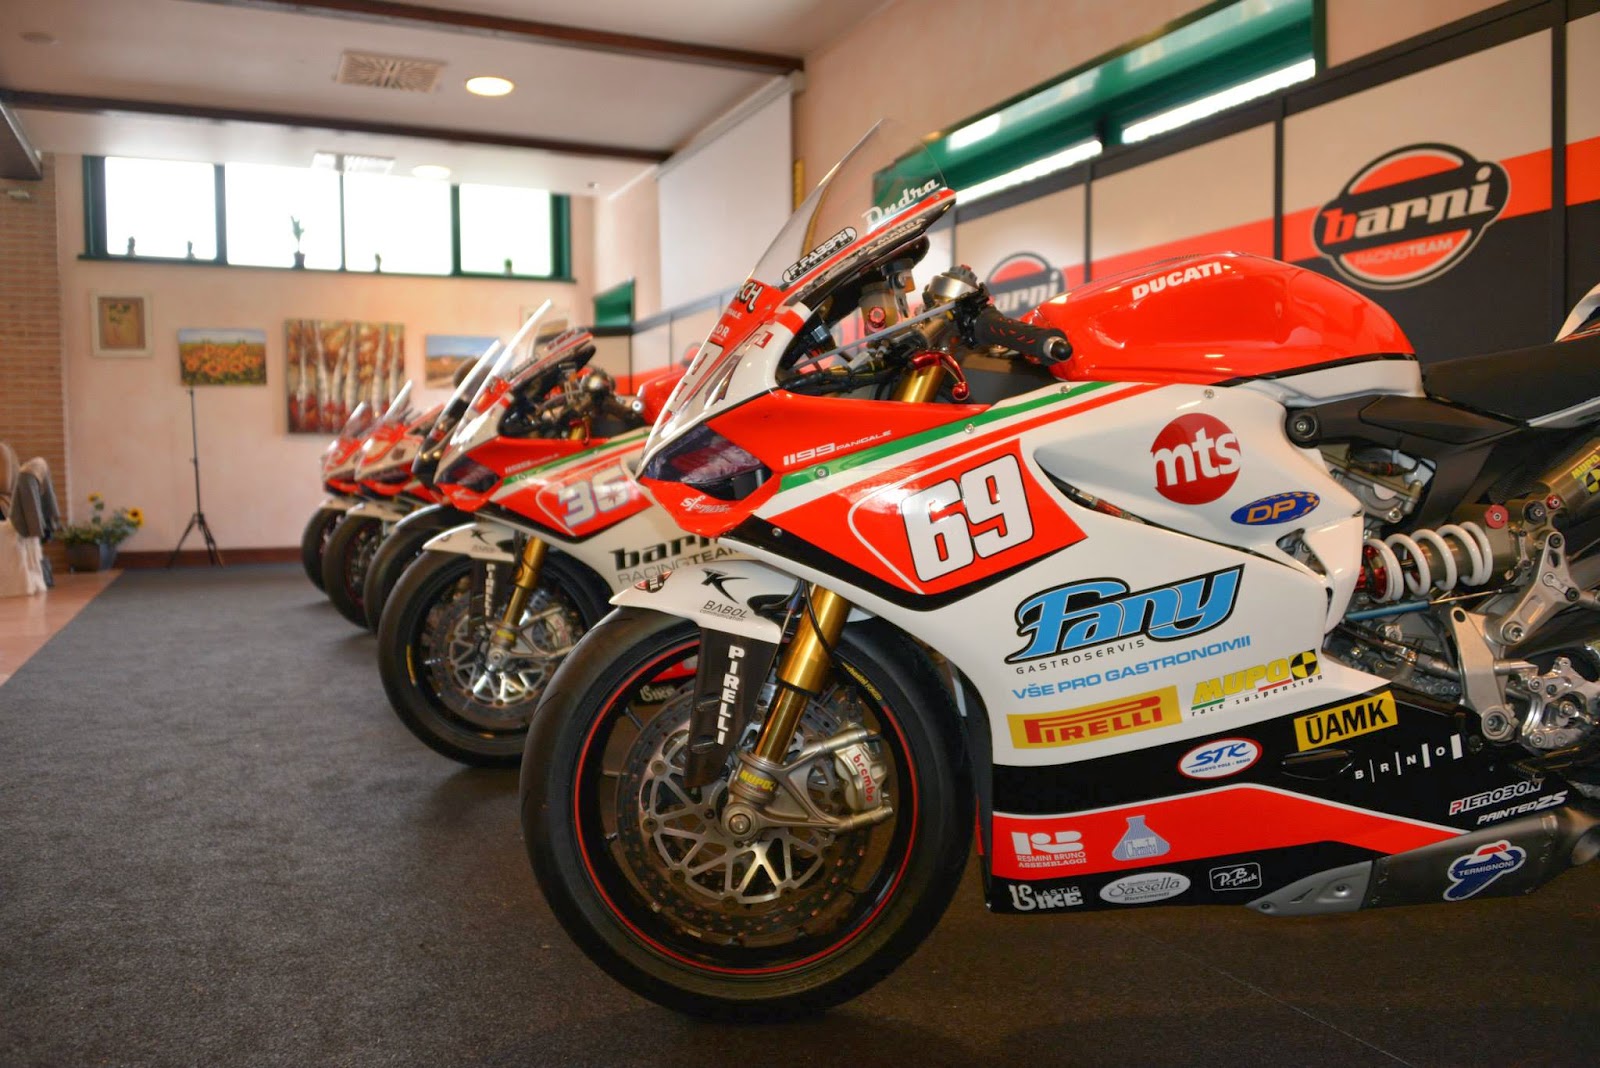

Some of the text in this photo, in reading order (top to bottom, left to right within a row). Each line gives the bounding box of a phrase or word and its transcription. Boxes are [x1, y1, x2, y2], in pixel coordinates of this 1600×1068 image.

[1322, 165, 1496, 246] barni
[994, 270, 1060, 316] arni
[1131, 262, 1222, 301] DUCATI
[1150, 426, 1241, 488] mts
[900, 453, 1035, 582] 69
[1246, 499, 1296, 523] DP
[618, 545, 739, 585] RACINGTEA
[1004, 563, 1245, 665] Fany
[1012, 635, 1251, 700] VŠE PRO GASTRONOMII
[1015, 639, 1145, 675] GASTROSERVIS
[717, 644, 745, 746] PIRELLI
[1192, 657, 1291, 705] MUPO
[1023, 696, 1163, 744] PIRELLI
[852, 753, 876, 802] brembo
[1186, 743, 1251, 769] STK
[1448, 780, 1543, 816] PIEROBON
[1016, 851, 1086, 863] RESMINI BRUNO
[1018, 858, 1087, 869] ASSEMBLAGGI
[1457, 860, 1515, 876] TERMIGNONI
[1108, 876, 1180, 898] Sassella
